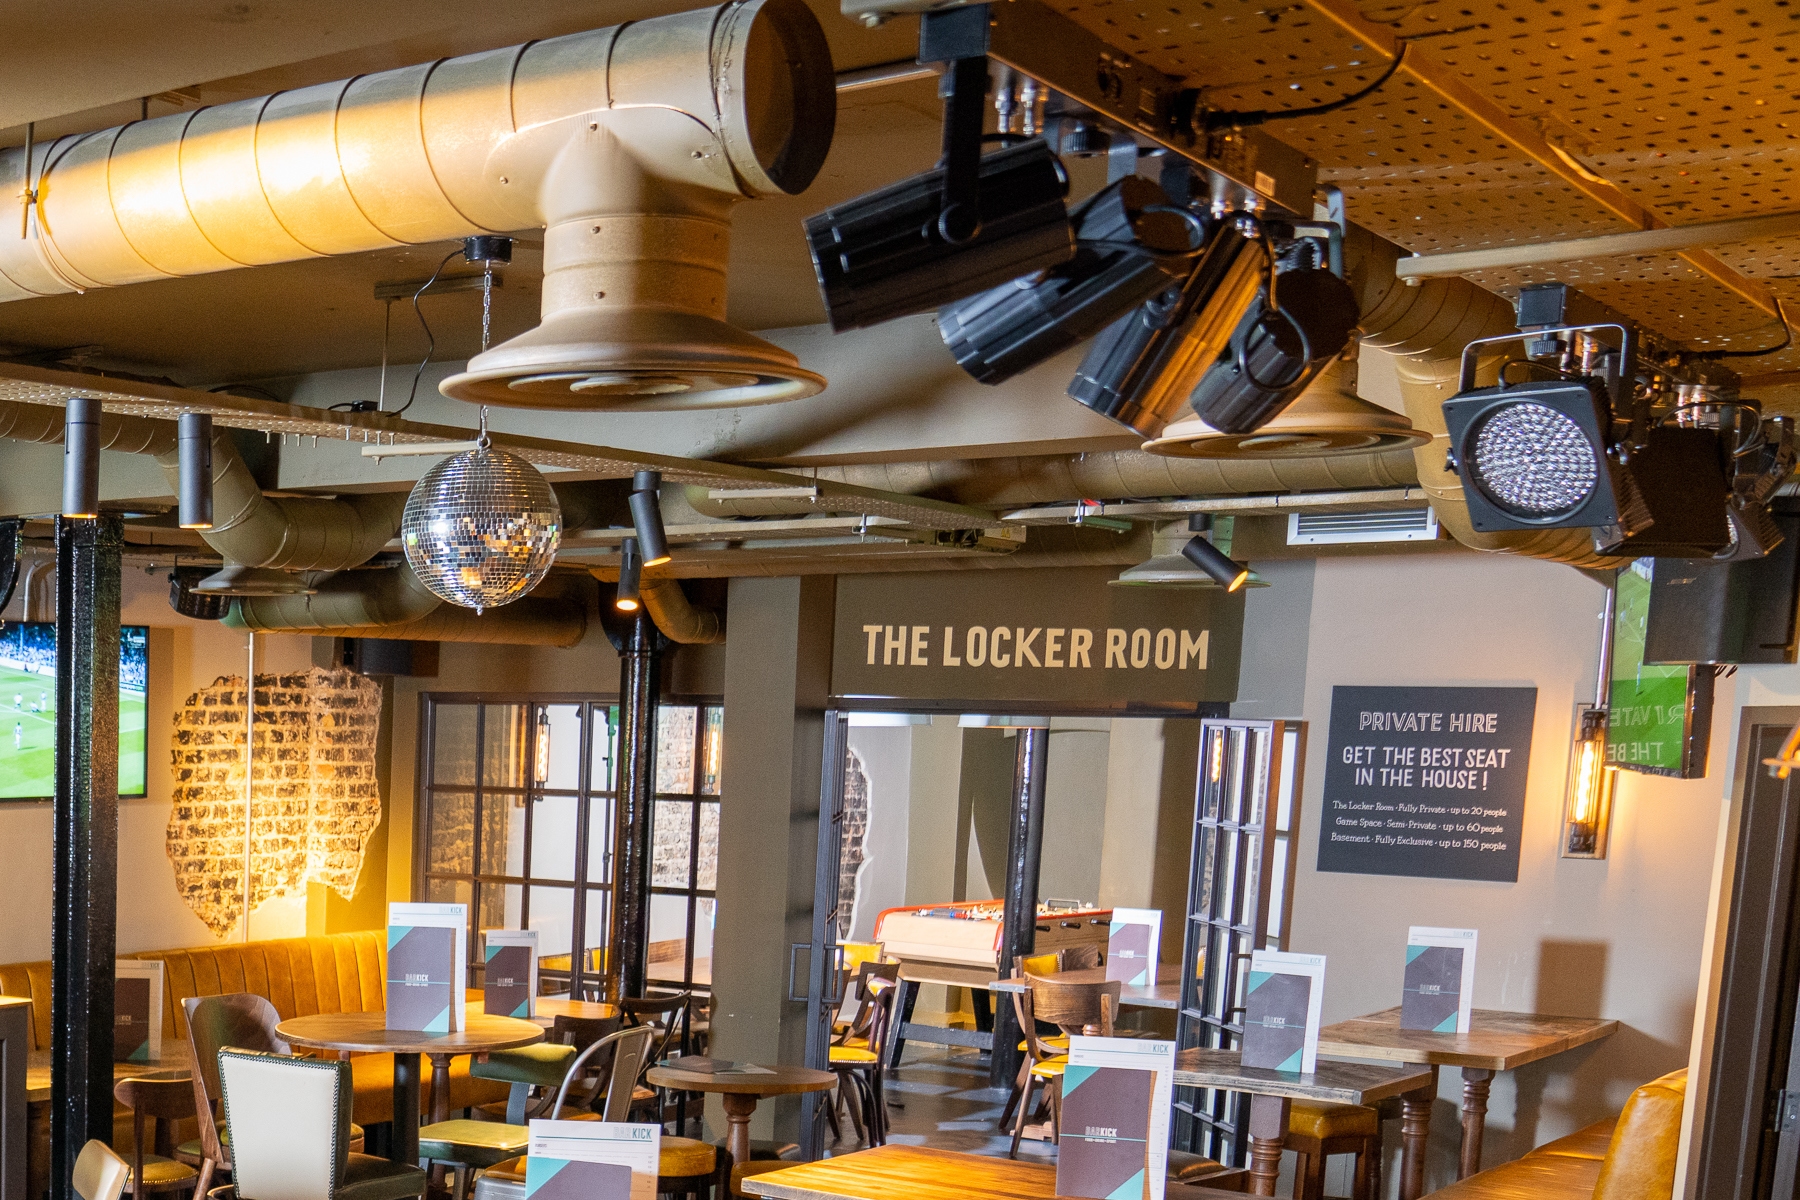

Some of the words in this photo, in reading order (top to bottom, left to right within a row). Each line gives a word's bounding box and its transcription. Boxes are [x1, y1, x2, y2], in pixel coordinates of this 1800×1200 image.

[862, 625, 930, 666] THE
[943, 626, 1093, 668] LOCKER
[1104, 628, 1210, 670] ROOM
[1359, 711, 1443, 732] PRIVATE
[1450, 713, 1498, 733] HIRE
[1342, 746, 1376, 764] GET
[1382, 747, 1415, 766] THE
[1420, 747, 1463, 768] BEST
[1465, 749, 1510, 768] SEAT
[1355, 768, 1373, 786] IN
[1380, 768, 1413, 787] THE
[1332, 800, 1347, 809] The
[1348, 802, 1374, 811] Locker
[1375, 802, 1394, 811] Room
[1398, 803, 1418, 814] Fully
[1419, 804, 1446, 814] Private
[1450, 807, 1460, 815] up
[1471, 806, 1482, 816] 20
[1483, 808, 1507, 818] people
[1336, 817, 1357, 826] Game
[1359, 818, 1382, 828] Space
[1442, 823, 1454, 832] up
[1456, 823, 1465, 831] to
[1466, 822, 1480, 832] 60
[1480, 825, 1504, 834] people
[1331, 832, 1370, 843] Basement
[1374, 836, 1396, 846] Fully
[1396, 837, 1434, 846] Exclusive
[1438, 840, 1450, 848] up
[1452, 839, 1461, 848] to
[1462, 838, 1479, 848] 150
[1480, 841, 1507, 851] people
[1153, 1044, 1169, 1053] KICK
[632, 1127, 652, 1139] KICK
